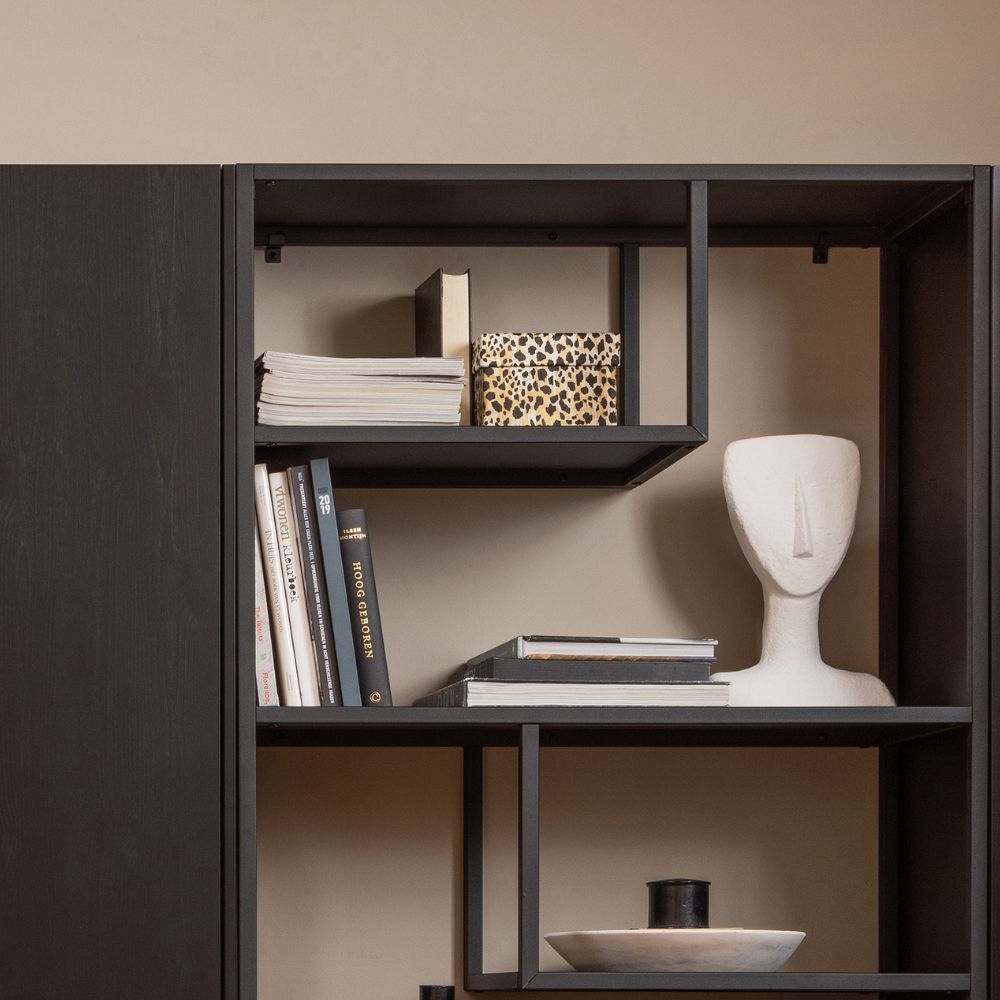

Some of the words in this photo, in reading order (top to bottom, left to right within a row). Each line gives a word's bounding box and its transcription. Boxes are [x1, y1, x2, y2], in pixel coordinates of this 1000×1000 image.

[318, 494, 330, 505] 20
[320, 504, 331, 515] 19
[274, 485, 290, 541] vtwonen
[282, 544, 298, 603] kleurboek
[352, 561, 365, 598] HOOG
[358, 601, 374, 658] GEBOREN
